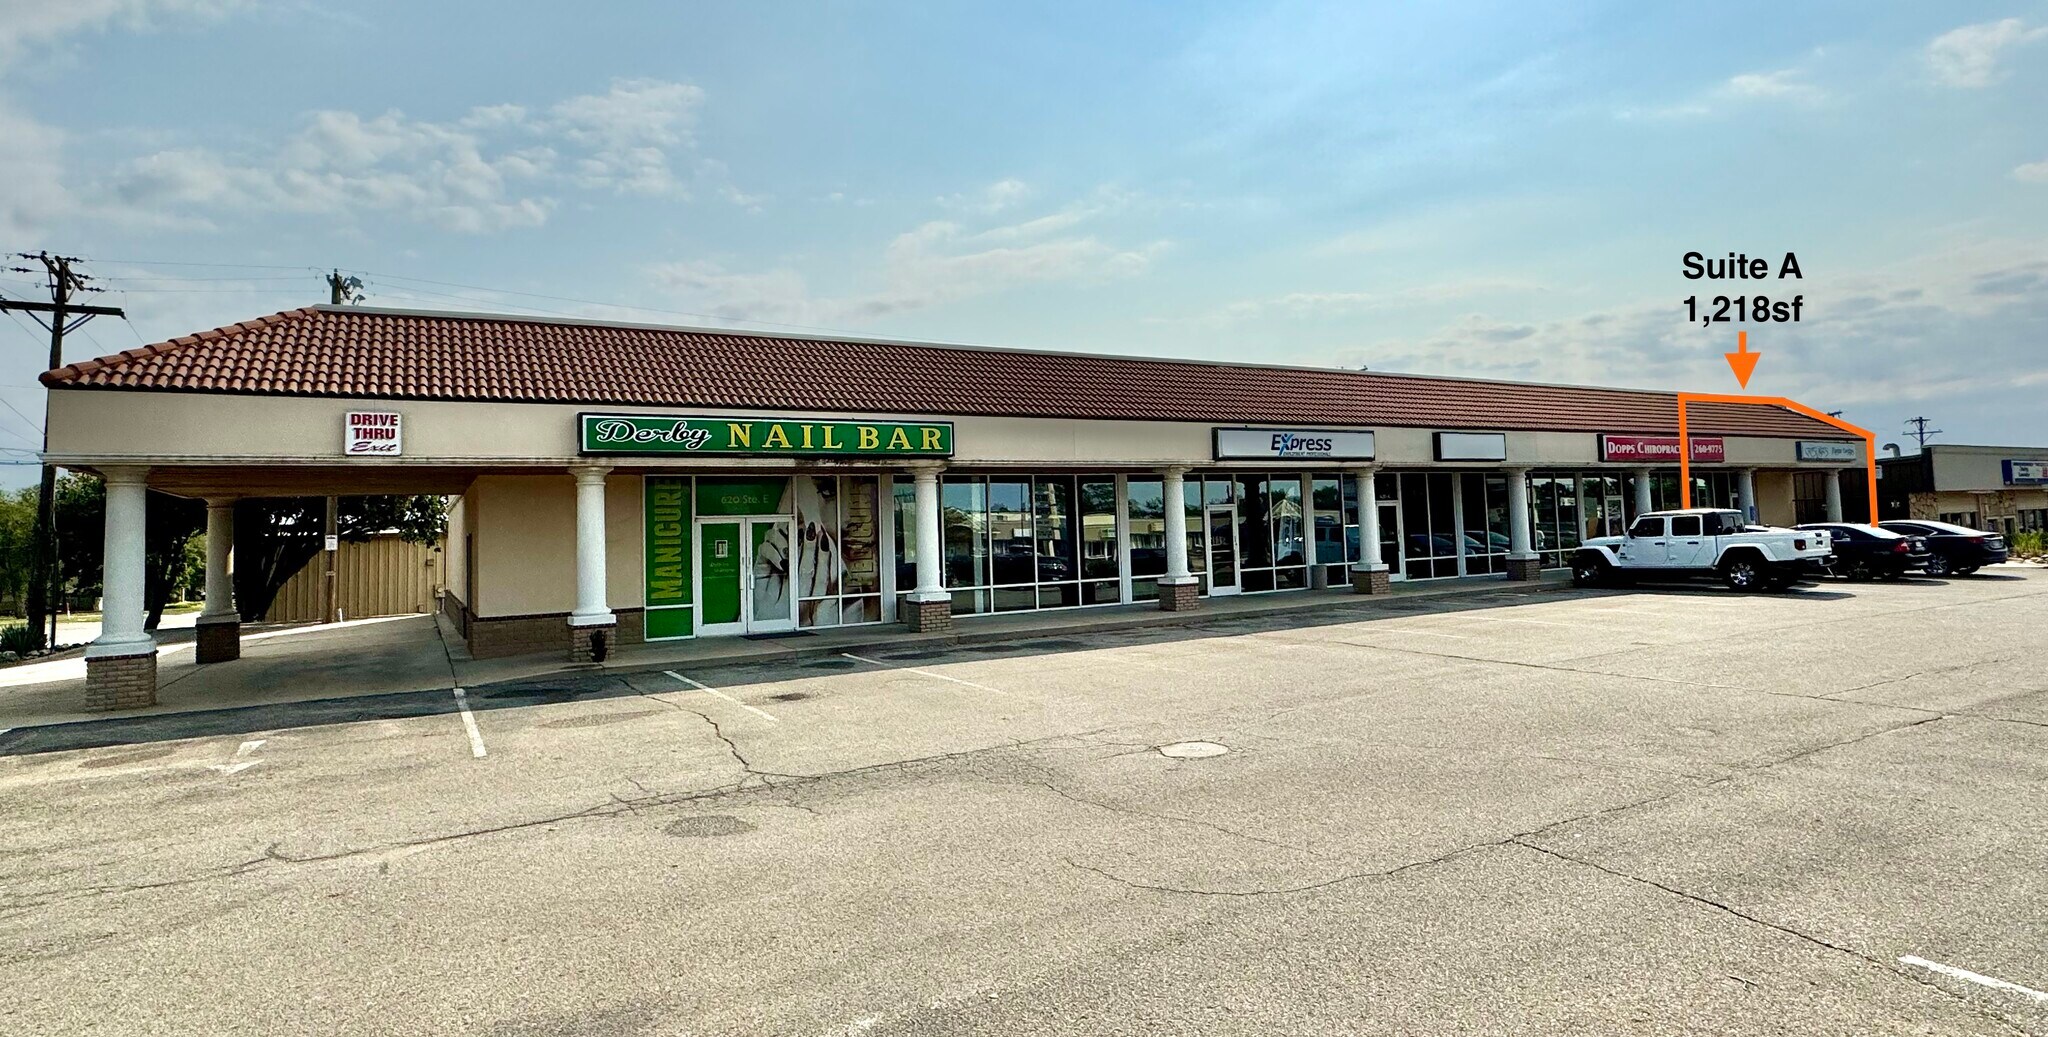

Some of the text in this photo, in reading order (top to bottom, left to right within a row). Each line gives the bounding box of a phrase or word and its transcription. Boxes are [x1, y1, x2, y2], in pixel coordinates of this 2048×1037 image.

[350, 414, 398, 426] DRIVE
[352, 427, 395, 440] THRU
[596, 419, 943, 450] Derby NAIL BAR
[350, 441, 397, 452] Exit
[1608, 441, 1635, 454] DOPPS
[1637, 441, 1682, 455] CHIROPRAC
[721, 495, 740, 504] 620
[763, 494, 770, 504] E
[649, 478, 684, 600] MANICURE
